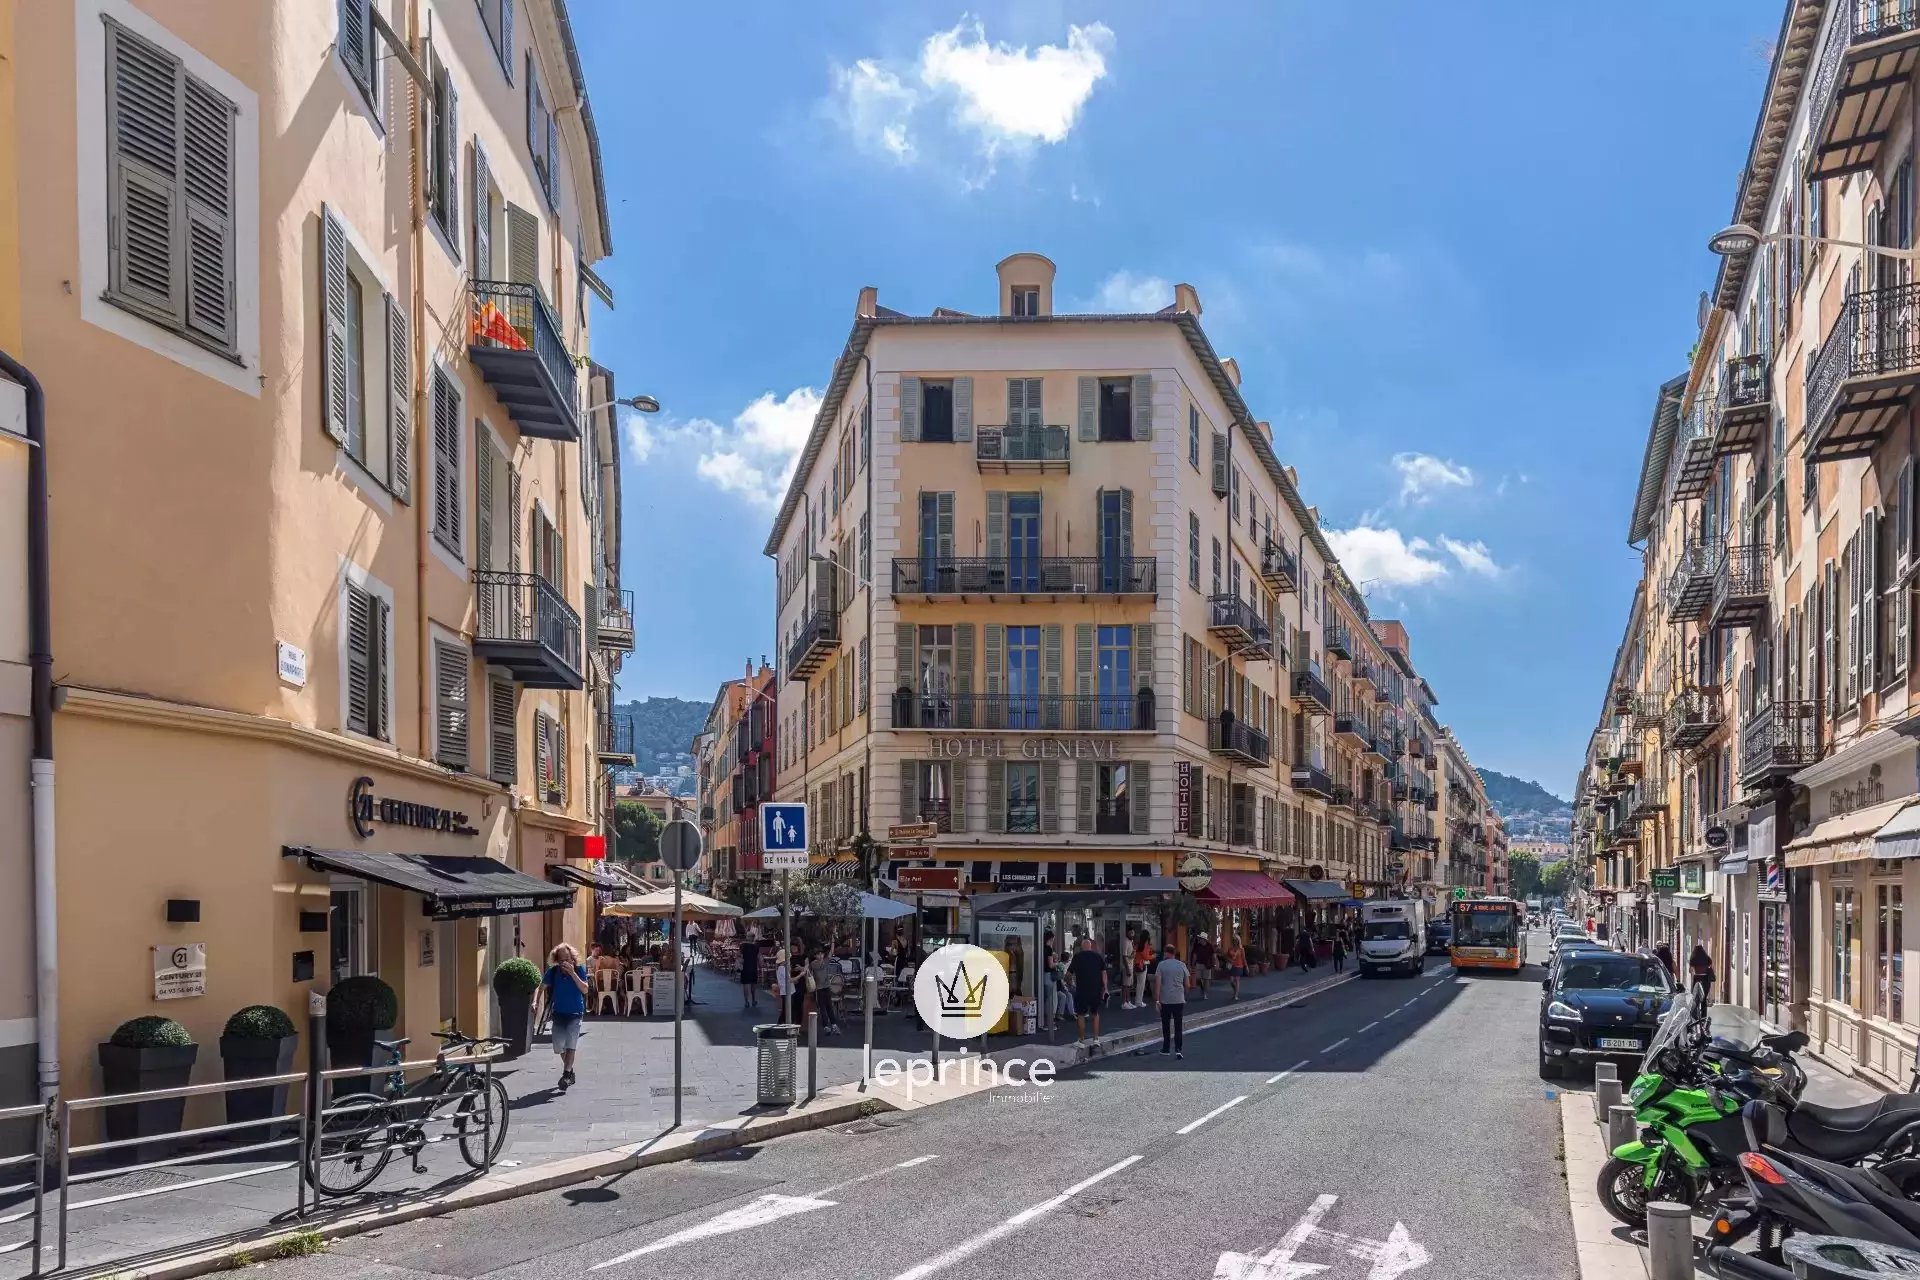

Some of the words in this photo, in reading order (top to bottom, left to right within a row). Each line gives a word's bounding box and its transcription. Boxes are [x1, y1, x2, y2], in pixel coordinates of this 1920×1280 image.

[1180, 763, 1189, 831] HOTEL
[381, 798, 441, 831] CENTURY
[764, 856, 774, 864] DE
[1655, 876, 1675, 887] bio
[1460, 903, 1471, 912] 57
[160, 972, 194, 980] CENTURY
